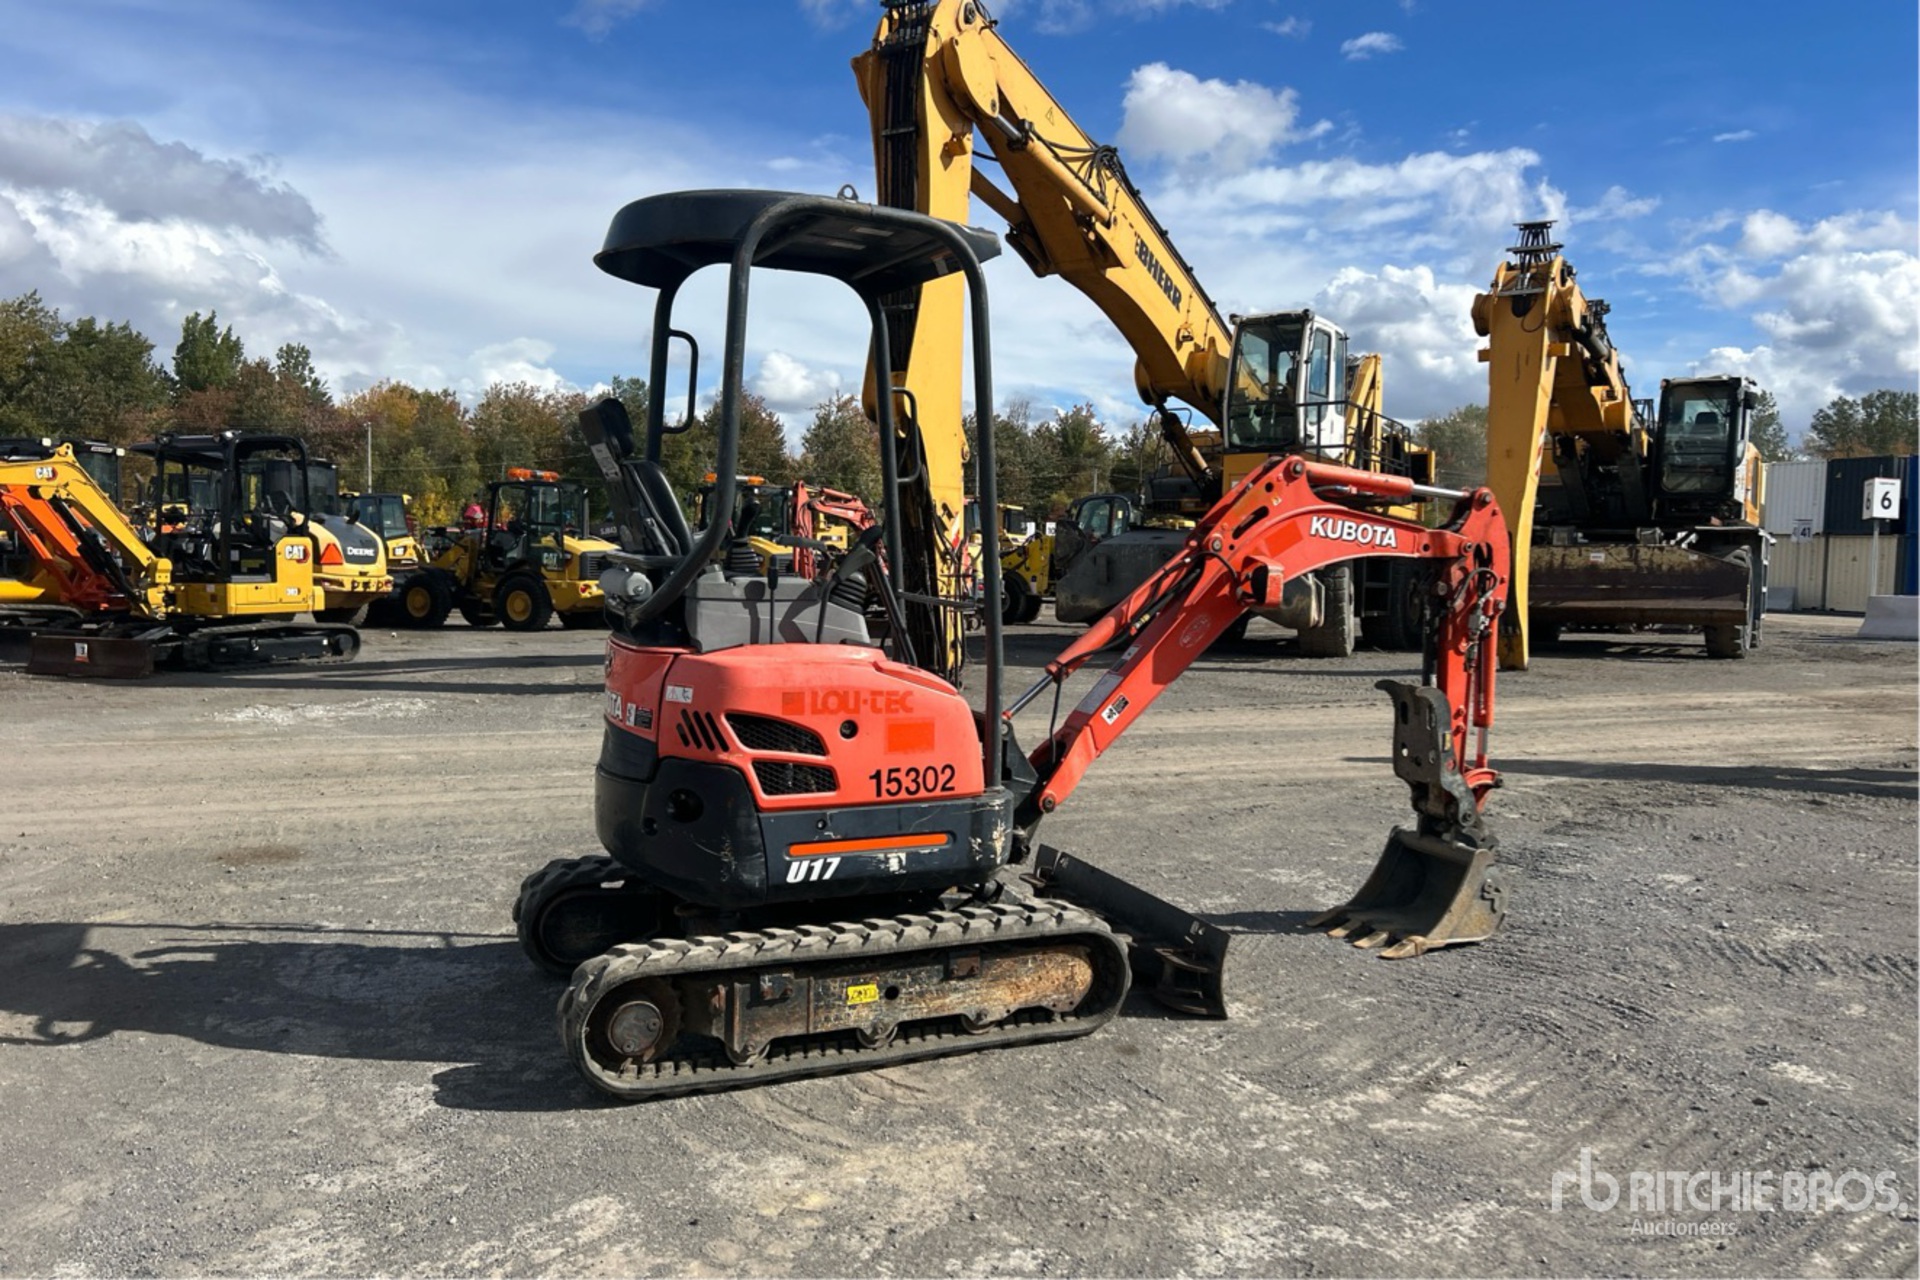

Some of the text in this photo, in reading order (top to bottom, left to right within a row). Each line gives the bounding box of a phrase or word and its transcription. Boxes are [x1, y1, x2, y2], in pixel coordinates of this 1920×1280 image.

[36, 467, 53, 480] CAT
[1881, 491, 1892, 510] 6
[1310, 516, 1398, 548] KUBOTA
[285, 545, 304, 560] CAT
[347, 546, 375, 557] DEERE
[869, 764, 956, 798] 15302
[786, 857, 846, 884] U17
